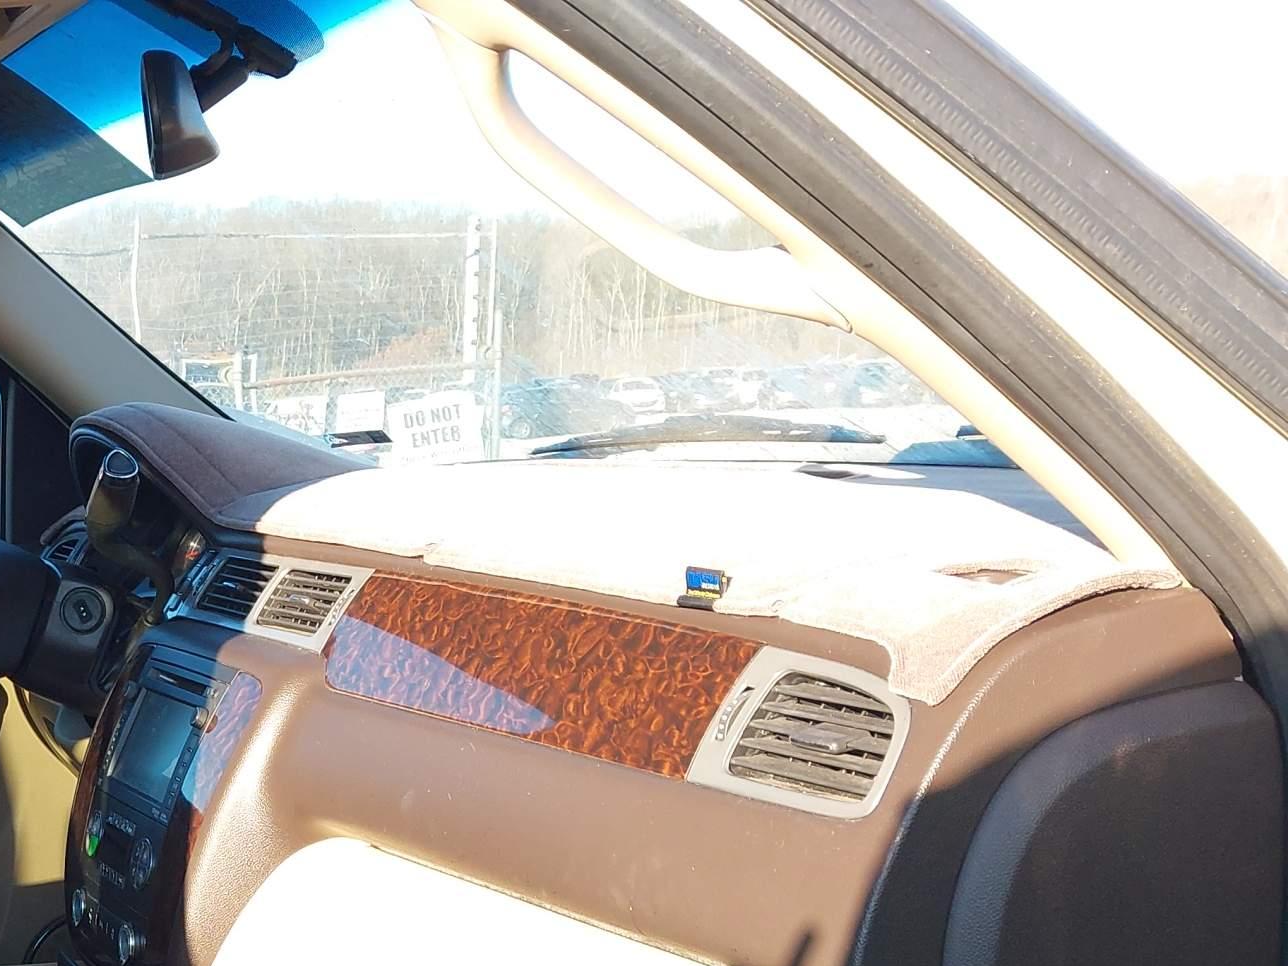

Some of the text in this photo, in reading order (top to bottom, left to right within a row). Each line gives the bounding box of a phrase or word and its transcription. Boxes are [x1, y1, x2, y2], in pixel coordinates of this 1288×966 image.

[403, 410, 426, 429] DO
[431, 403, 461, 423] NOT
[412, 425, 461, 448] ENTER
